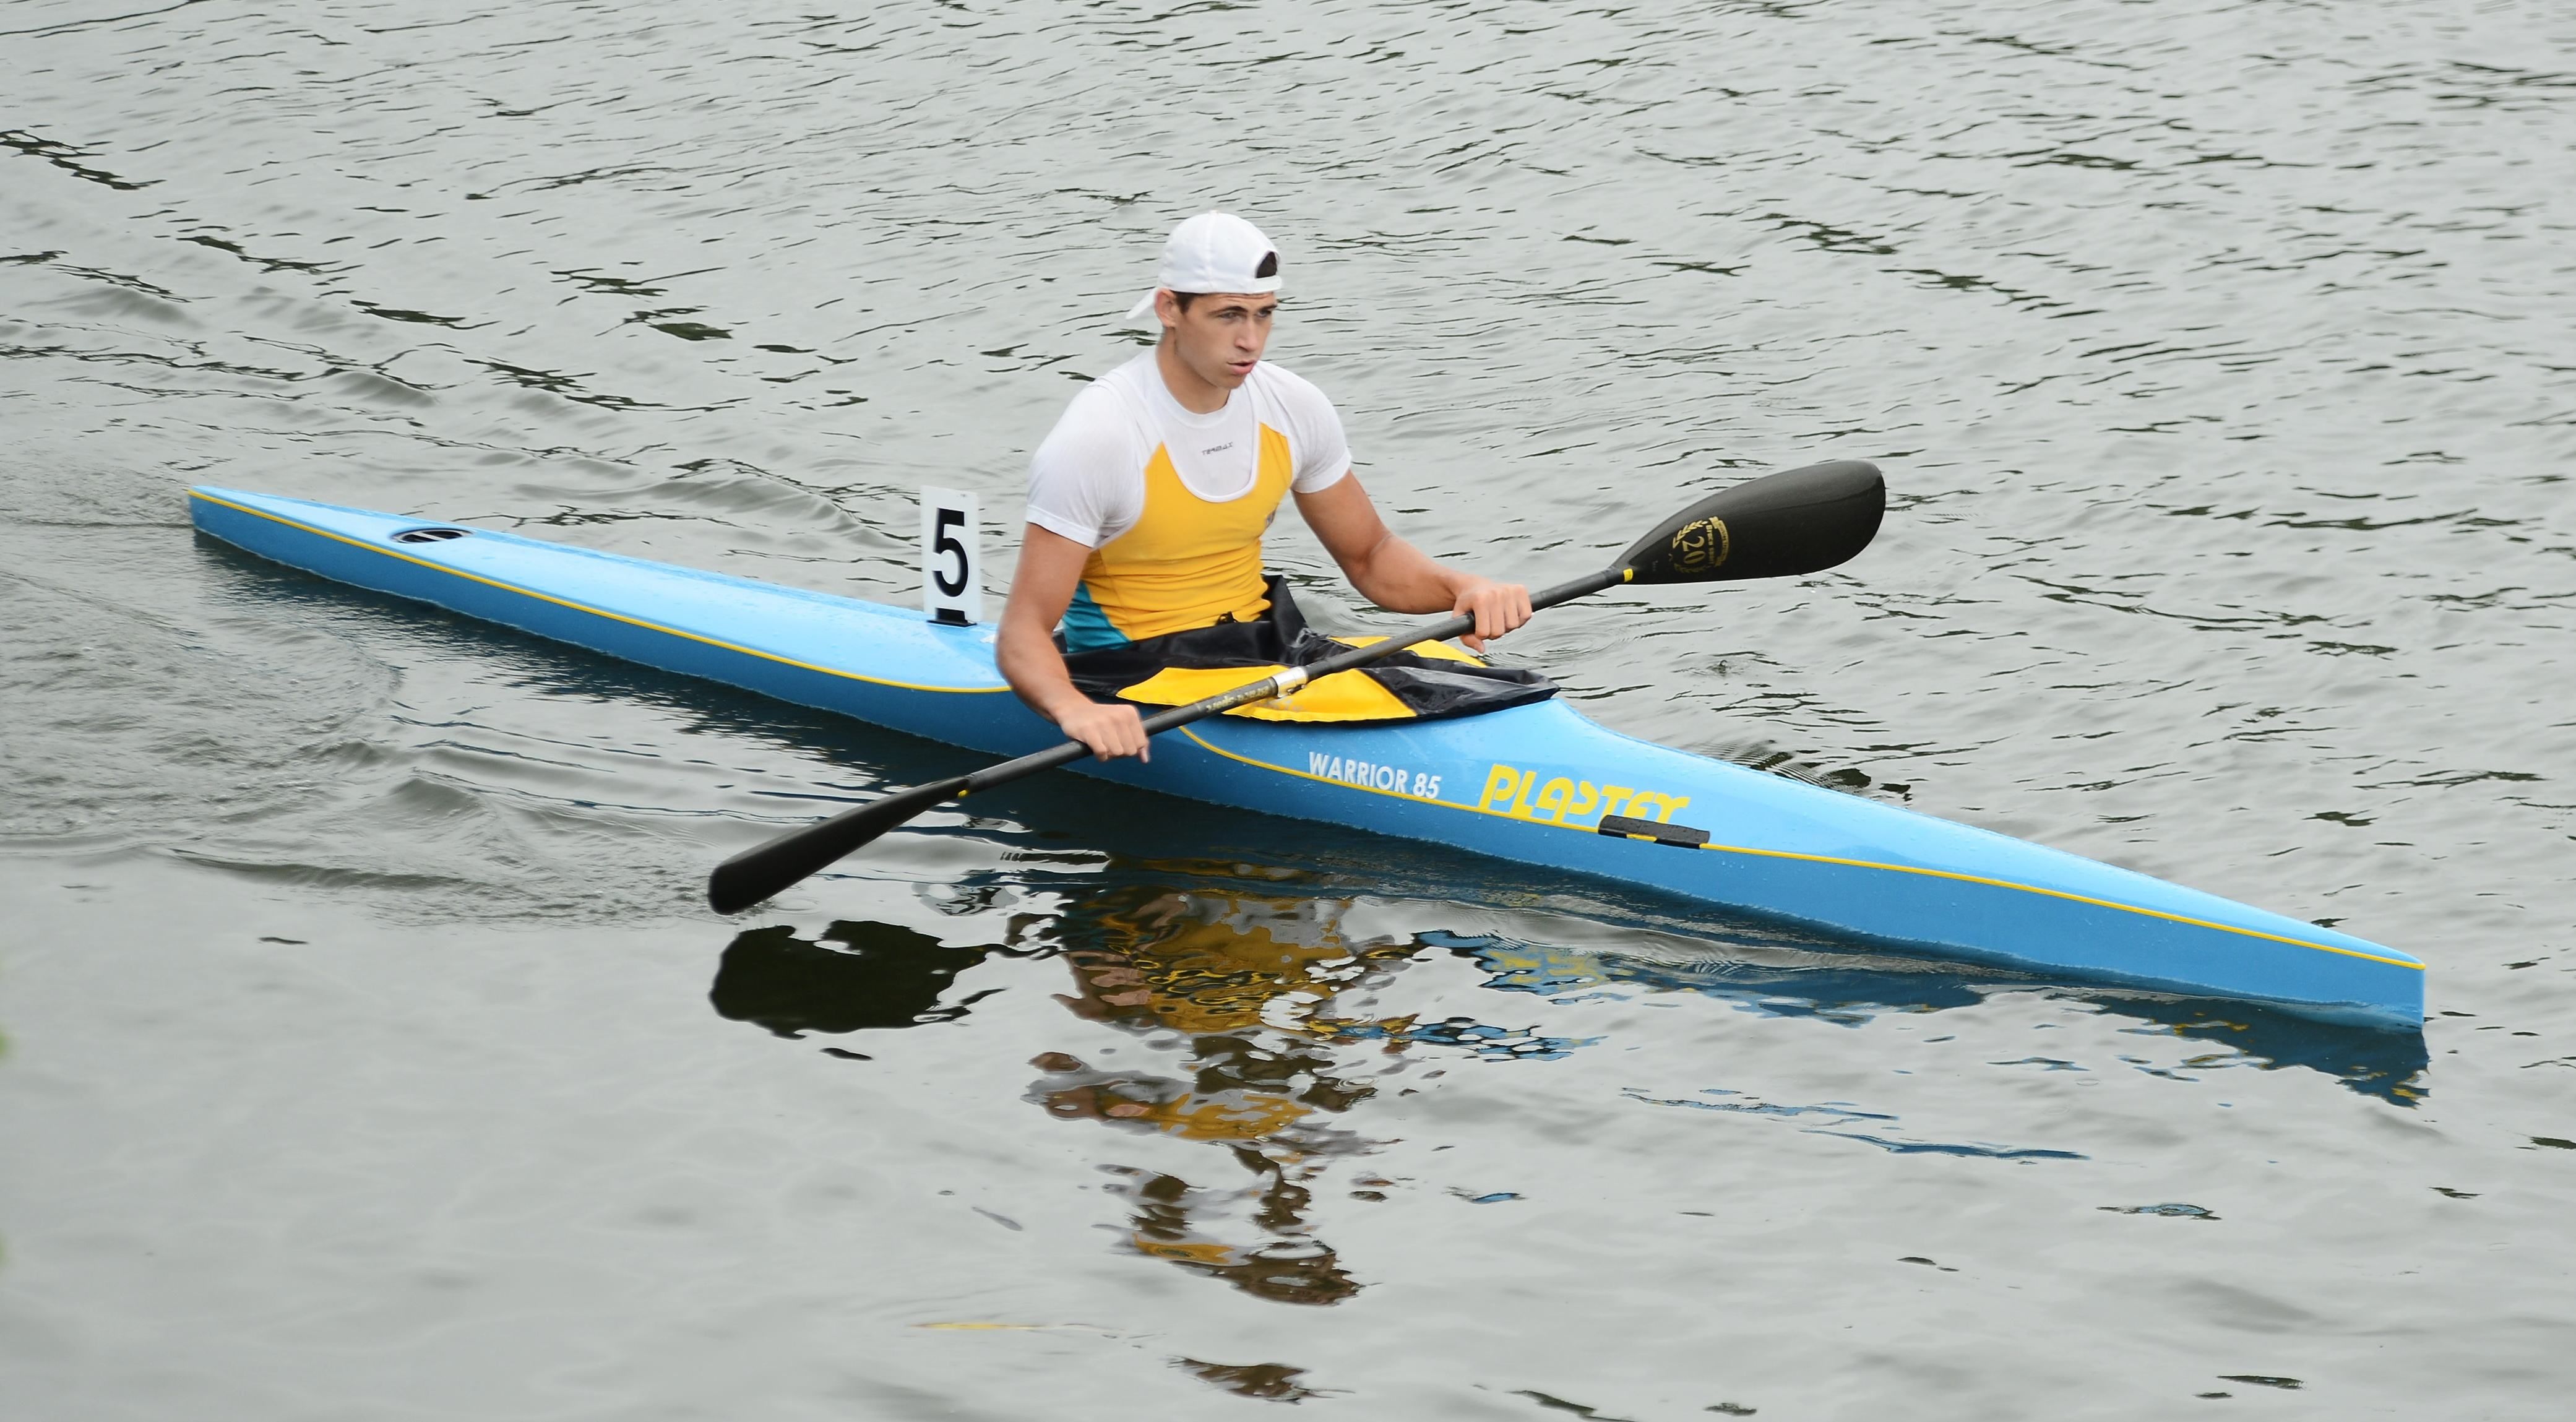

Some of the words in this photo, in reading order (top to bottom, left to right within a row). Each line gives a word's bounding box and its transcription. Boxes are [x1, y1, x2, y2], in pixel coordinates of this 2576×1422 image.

[933, 507, 968, 597] 5
[1682, 535, 1706, 564] 20
[1309, 751, 1408, 793] WARRIOR
[1413, 773, 1441, 799] 85
